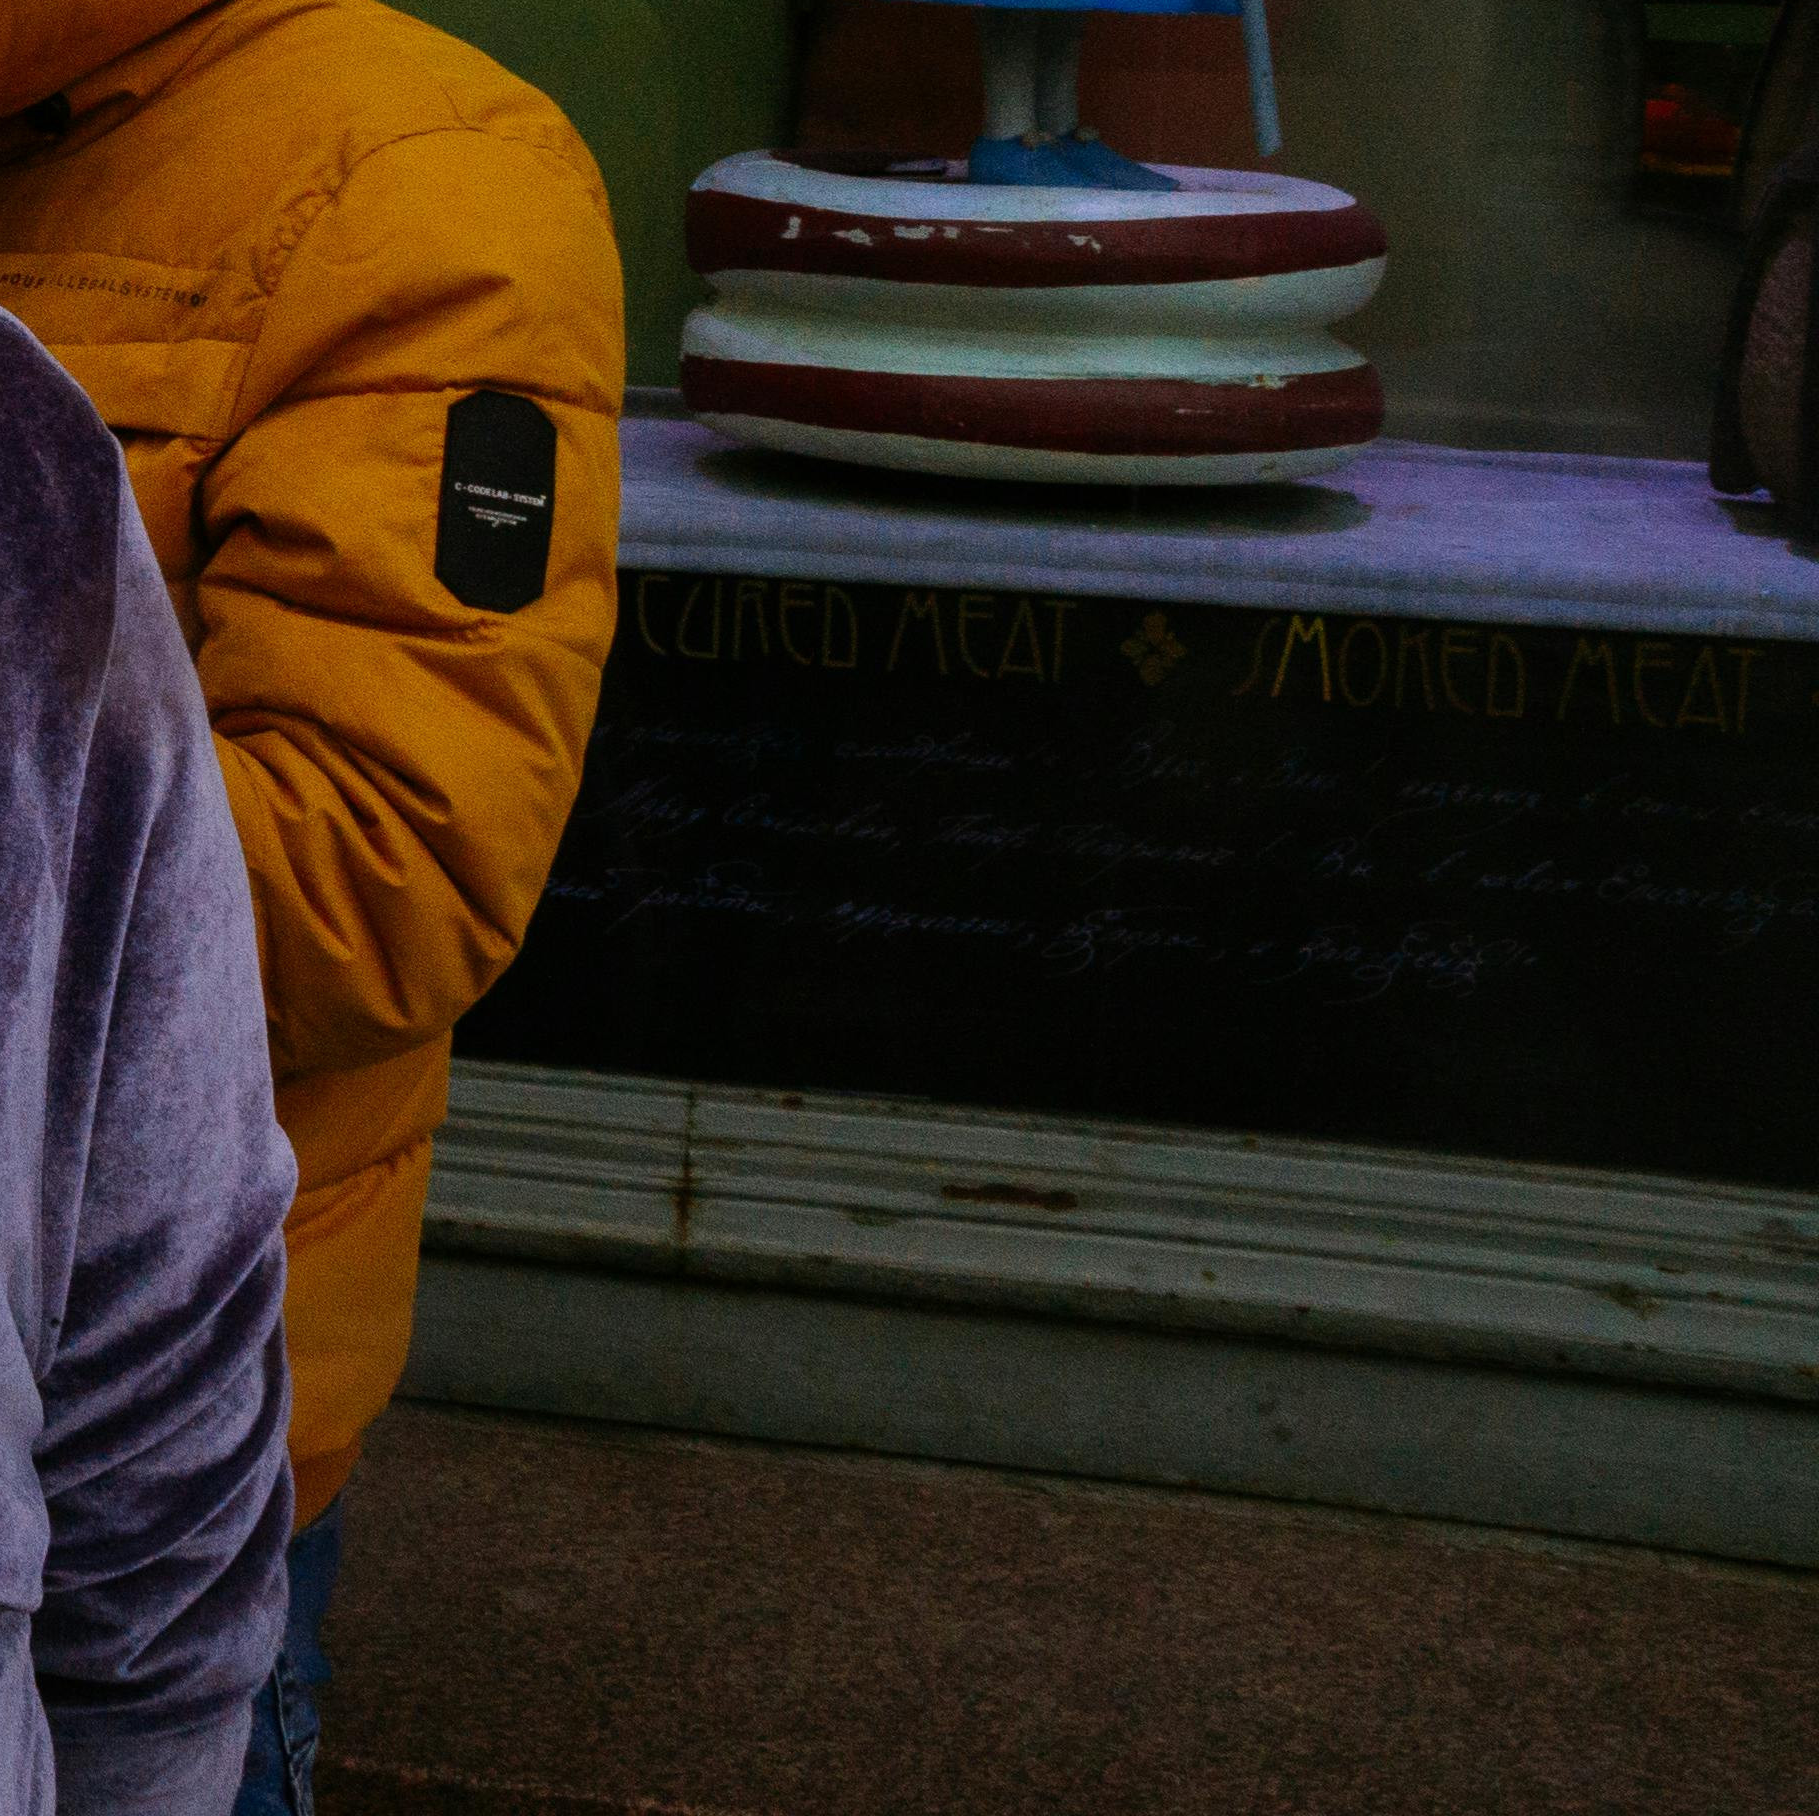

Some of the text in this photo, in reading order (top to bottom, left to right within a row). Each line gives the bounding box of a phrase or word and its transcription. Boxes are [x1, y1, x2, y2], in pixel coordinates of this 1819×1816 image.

[636, 573, 1078, 683] CURED MEAT
[1232, 614, 1764, 733] SMOKED MEAT
